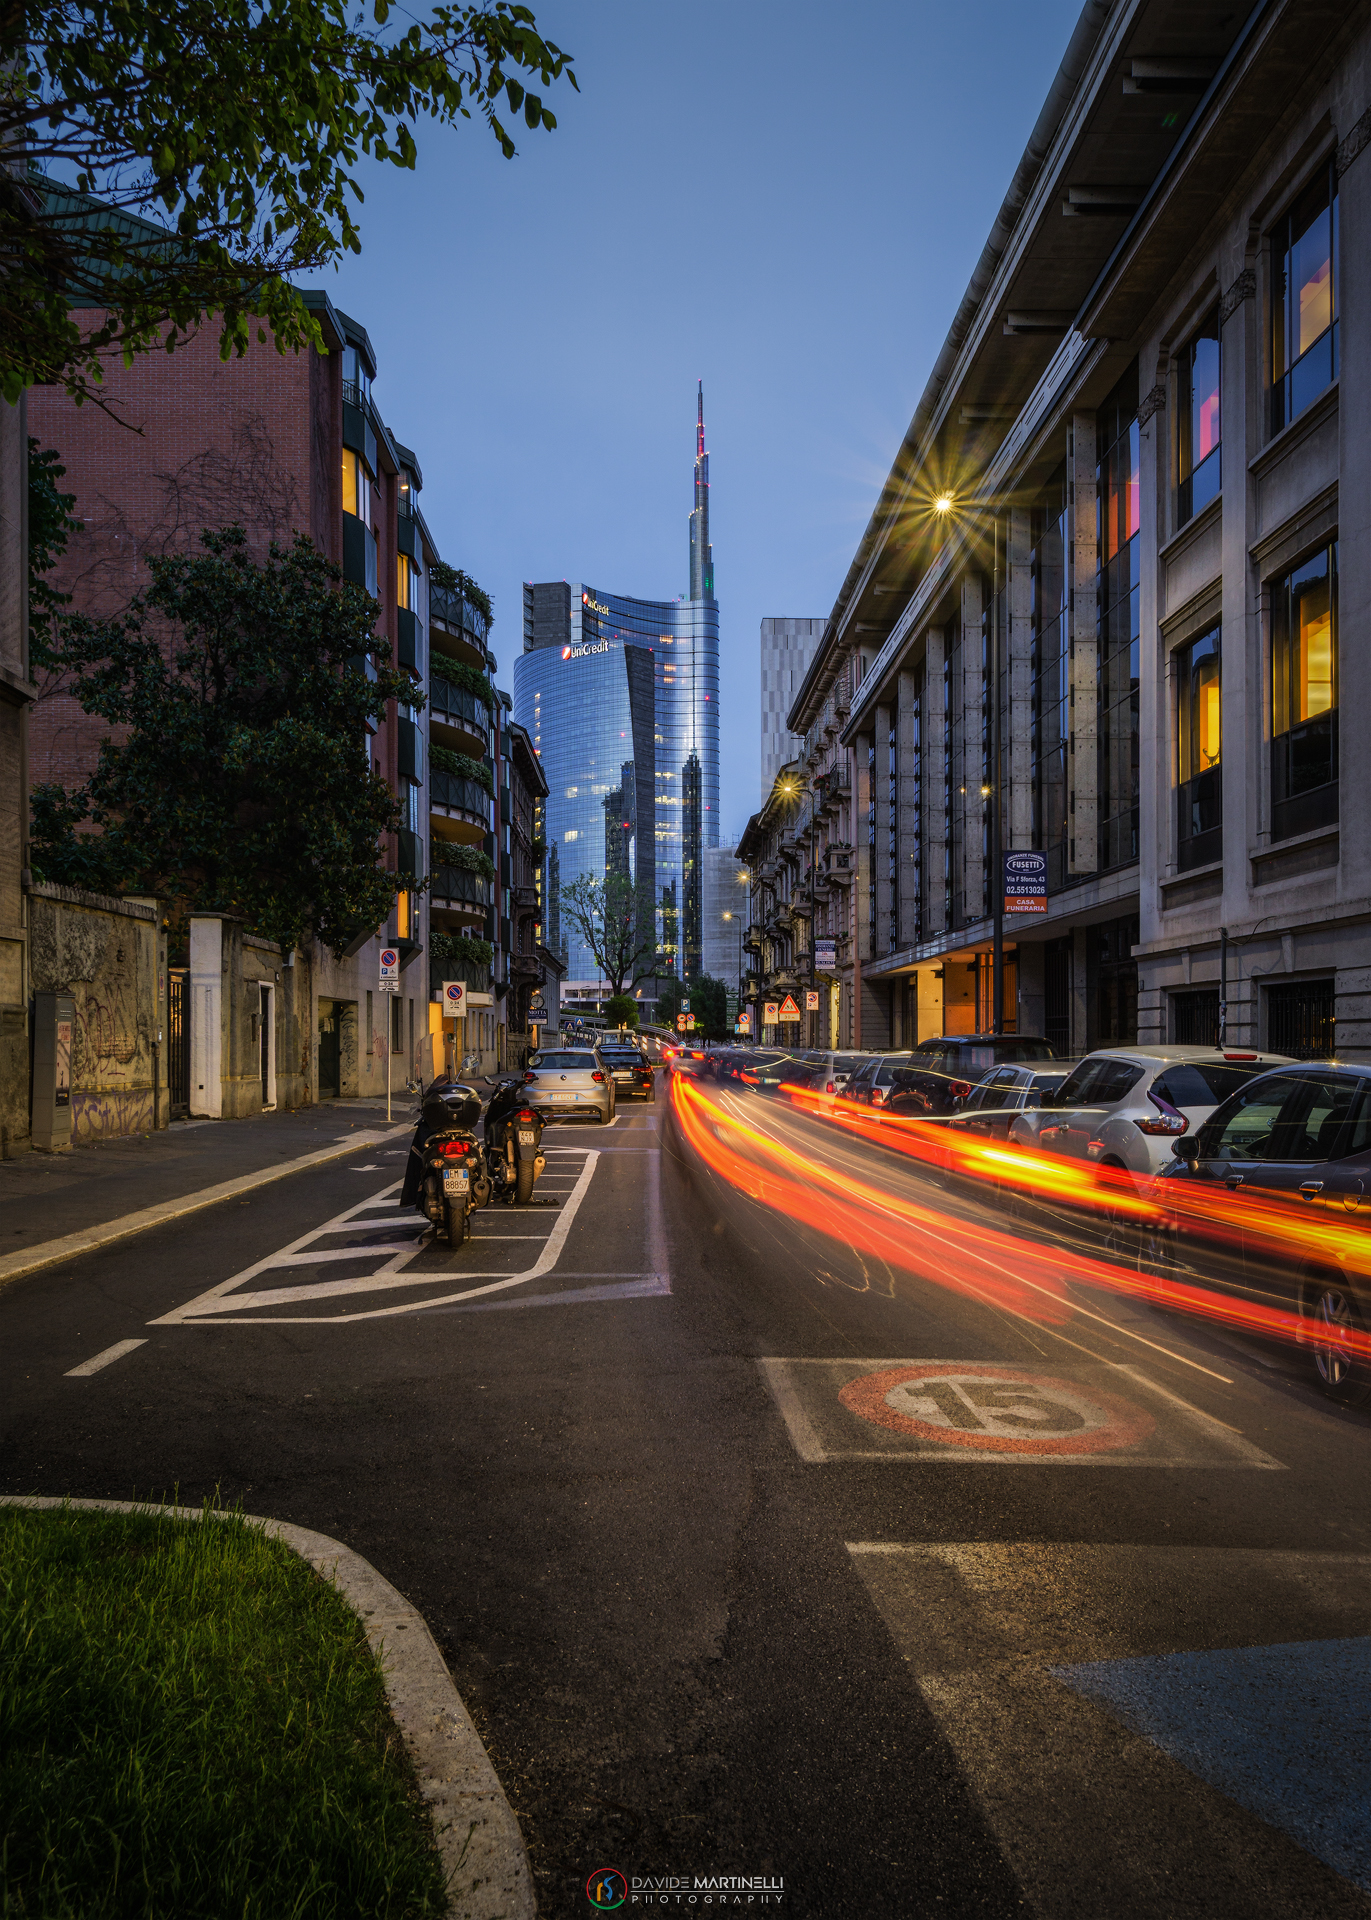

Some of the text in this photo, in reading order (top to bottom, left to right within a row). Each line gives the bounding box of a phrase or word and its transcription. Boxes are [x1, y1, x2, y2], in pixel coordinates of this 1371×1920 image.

[588, 597, 609, 616] UniCredit
[571, 640, 609, 658] UniCredit
[1020, 876, 1038, 884] Sforza,
[1006, 886, 1045, 894] 02.5513026
[449, 1169, 459, 1179] EM
[445, 1180, 468, 1190] 88857
[905, 1381, 1086, 1432] 15
